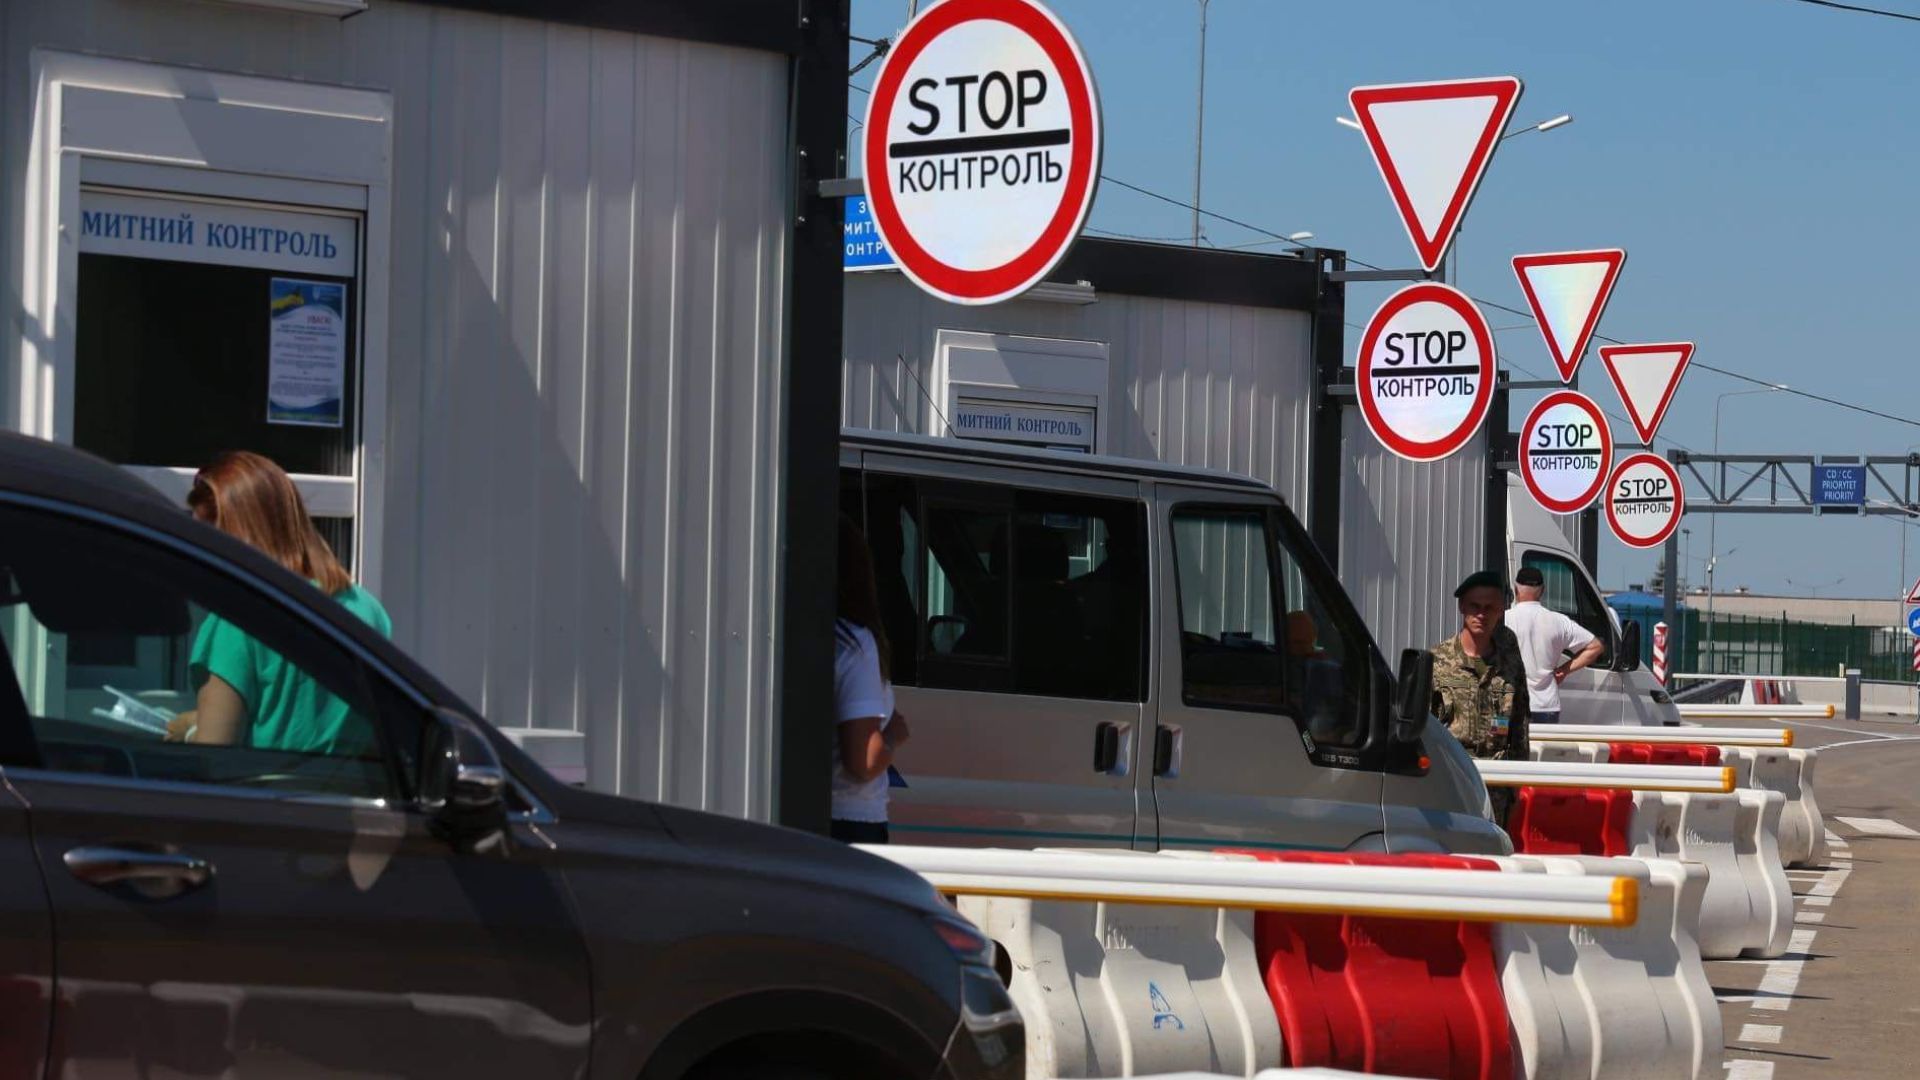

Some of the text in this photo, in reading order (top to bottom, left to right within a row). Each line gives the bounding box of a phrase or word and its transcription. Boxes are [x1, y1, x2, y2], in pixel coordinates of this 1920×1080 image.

[907, 69, 1047, 135] STOP
[899, 150, 1063, 193] КОНТРОЛЬ
[858, 201, 866, 214] З
[82, 210, 337, 259] МИТНИЙ КОНТРОЛЬ
[844, 221, 877, 235] МИТ
[846, 241, 884, 256] ОНТР
[1384, 330, 1466, 365] STOP
[1377, 376, 1475, 398] КОНТРОЛЬ
[957, 413, 1082, 436] МИТНИЙ КОНТРОЛЬ
[1537, 423, 1593, 448] STOP
[1532, 456, 1598, 470] КОНТРОЛЬ
[1826, 469, 1837, 479] CD
[1619, 478, 1667, 497] STOP
[1822, 480, 1857, 489] PRIORYTET
[1824, 491, 1854, 500] PRIORITY
[1615, 502, 1671, 515] КОНТРОЛЬ
